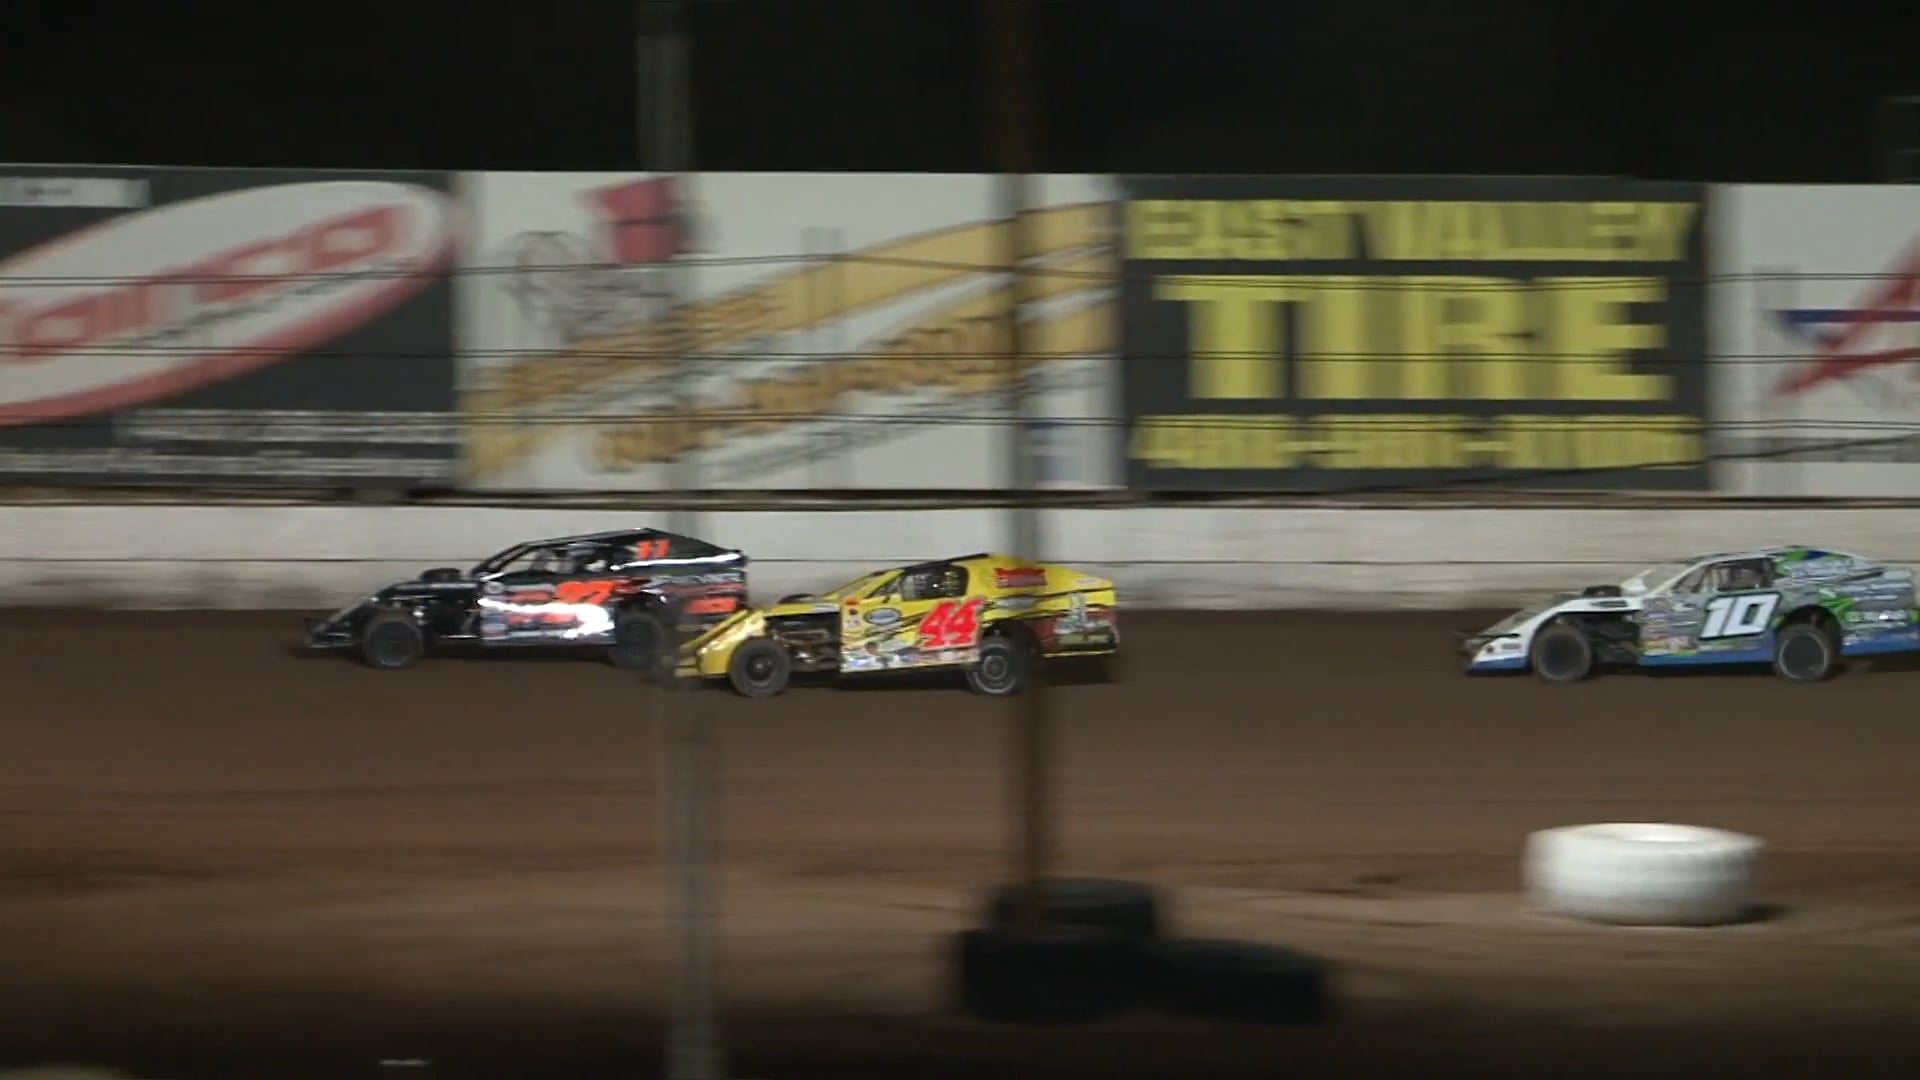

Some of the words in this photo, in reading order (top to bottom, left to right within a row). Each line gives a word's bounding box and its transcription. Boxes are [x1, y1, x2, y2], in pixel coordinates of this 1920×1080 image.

[1126, 200, 1362, 262] EAST
[1153, 275, 1674, 400] TIRE
[919, 597, 983, 647] 44
[1701, 593, 1780, 639] 10
